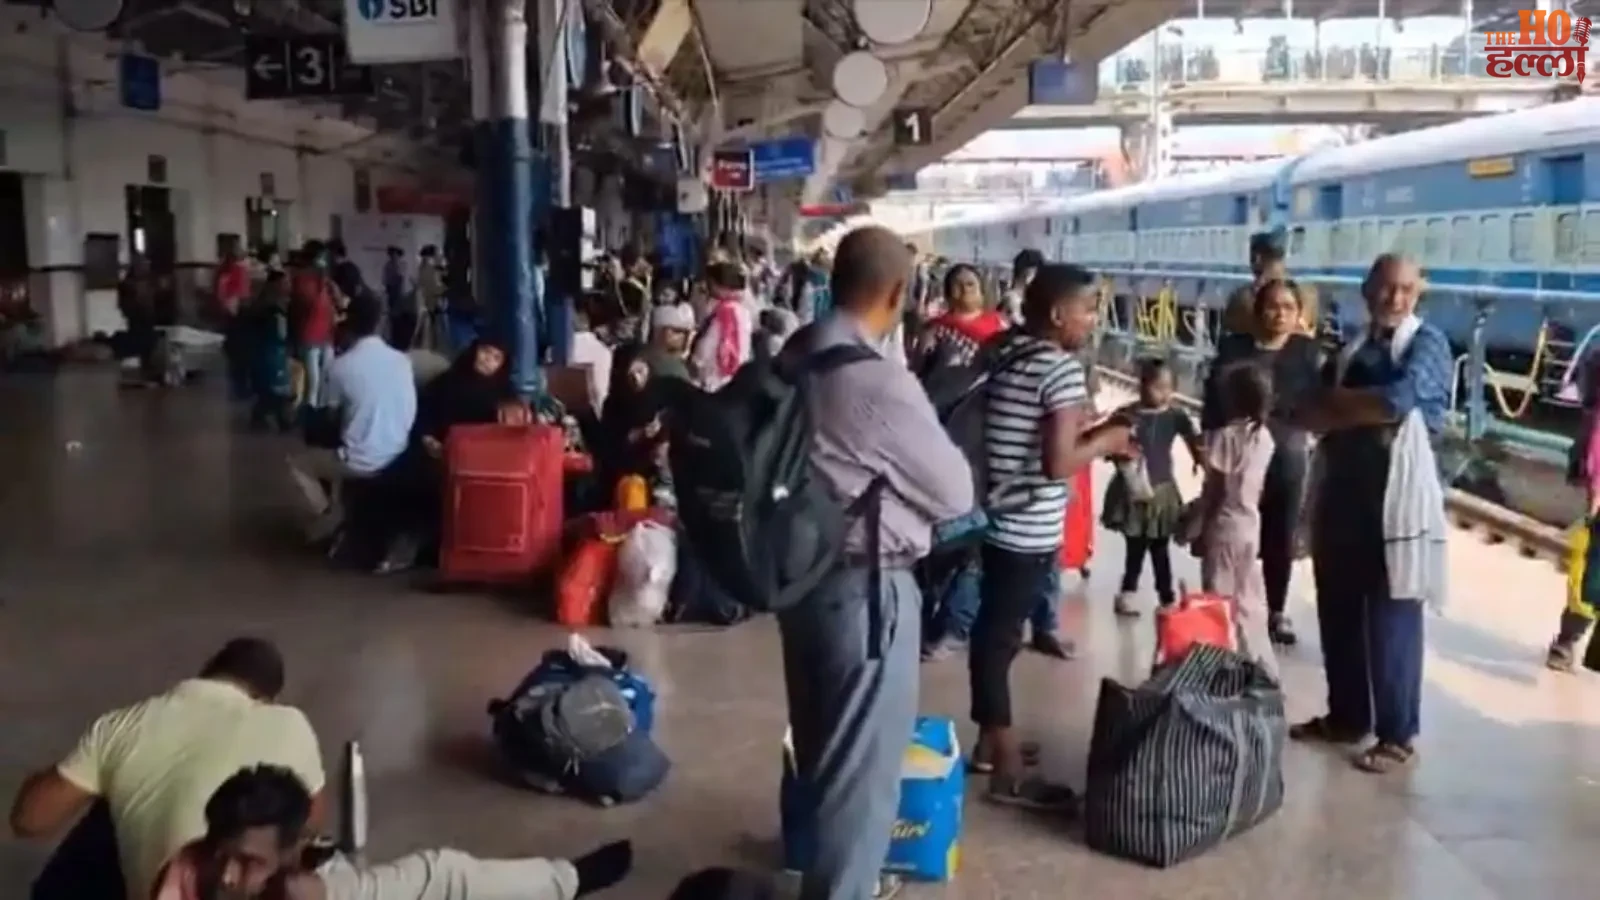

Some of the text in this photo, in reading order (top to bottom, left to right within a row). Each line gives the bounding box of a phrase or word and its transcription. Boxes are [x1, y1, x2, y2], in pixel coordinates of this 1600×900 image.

[389, 0, 437, 19] SBI
[296, 47, 324, 84] 3
[905, 111, 920, 142] 1
